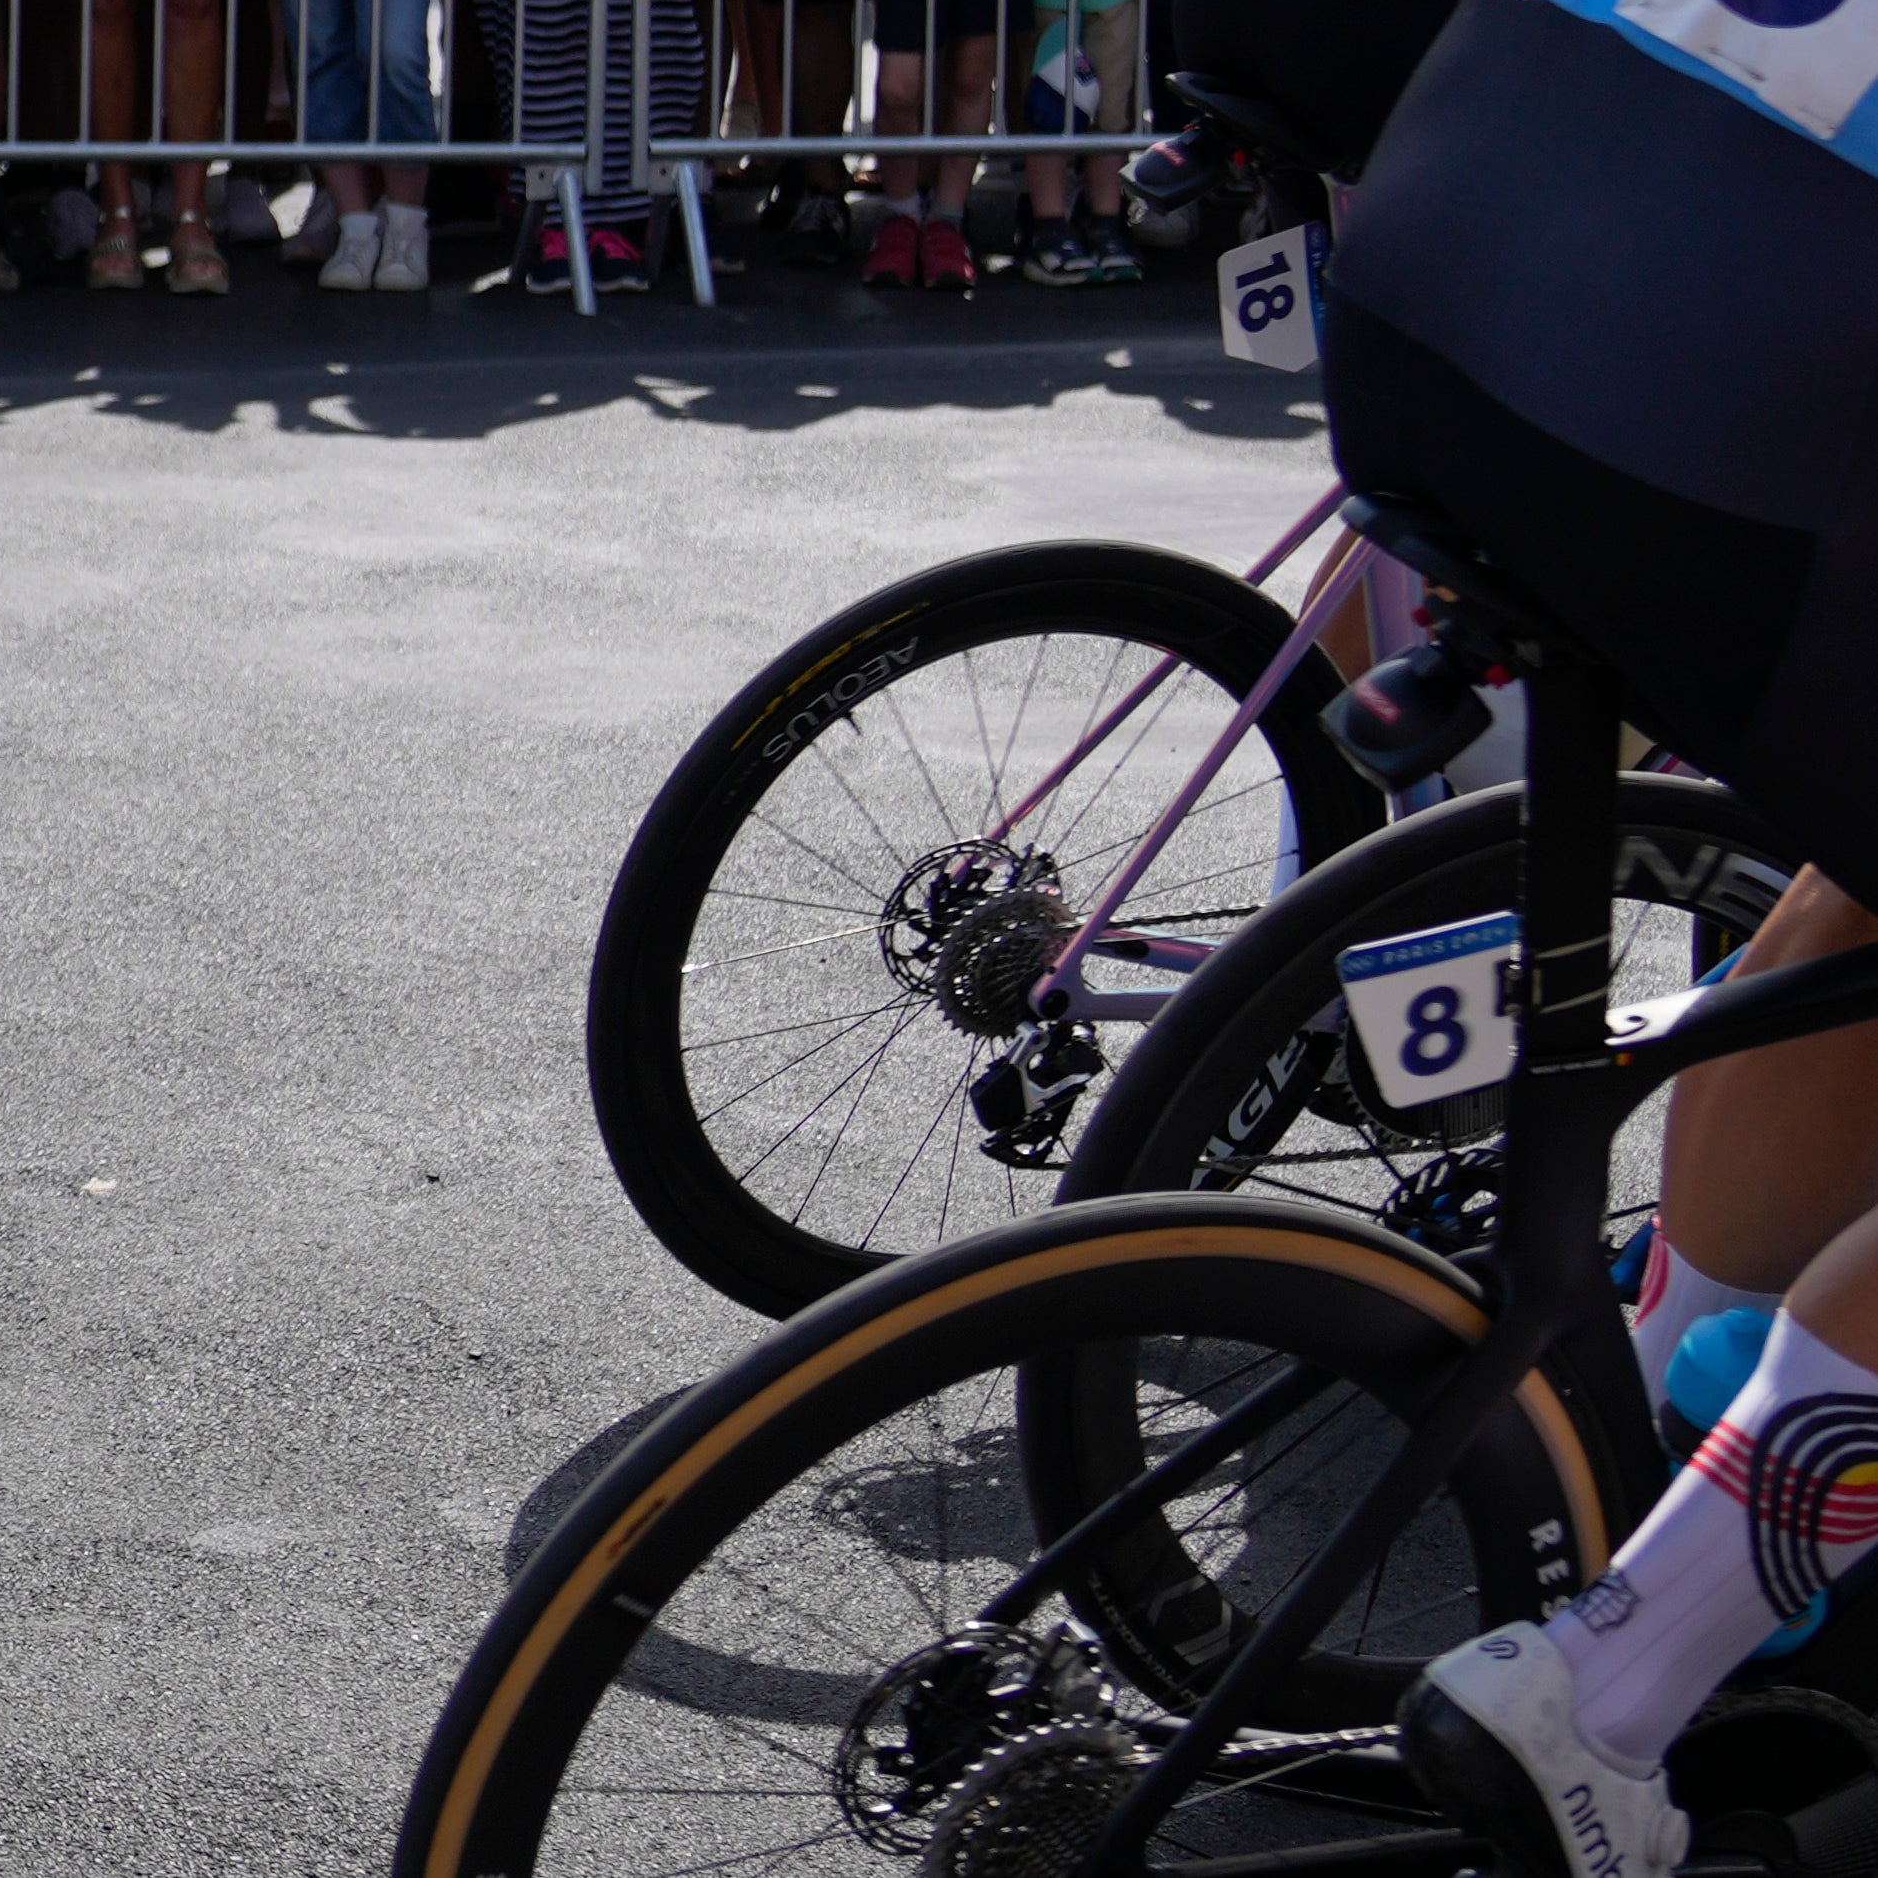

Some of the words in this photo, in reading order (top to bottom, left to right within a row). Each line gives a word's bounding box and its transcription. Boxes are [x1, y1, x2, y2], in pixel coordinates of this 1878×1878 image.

[1235, 250, 1295, 334] 18
[761, 635, 920, 764] AEOLUS
[1400, 985, 1469, 1077] 8
